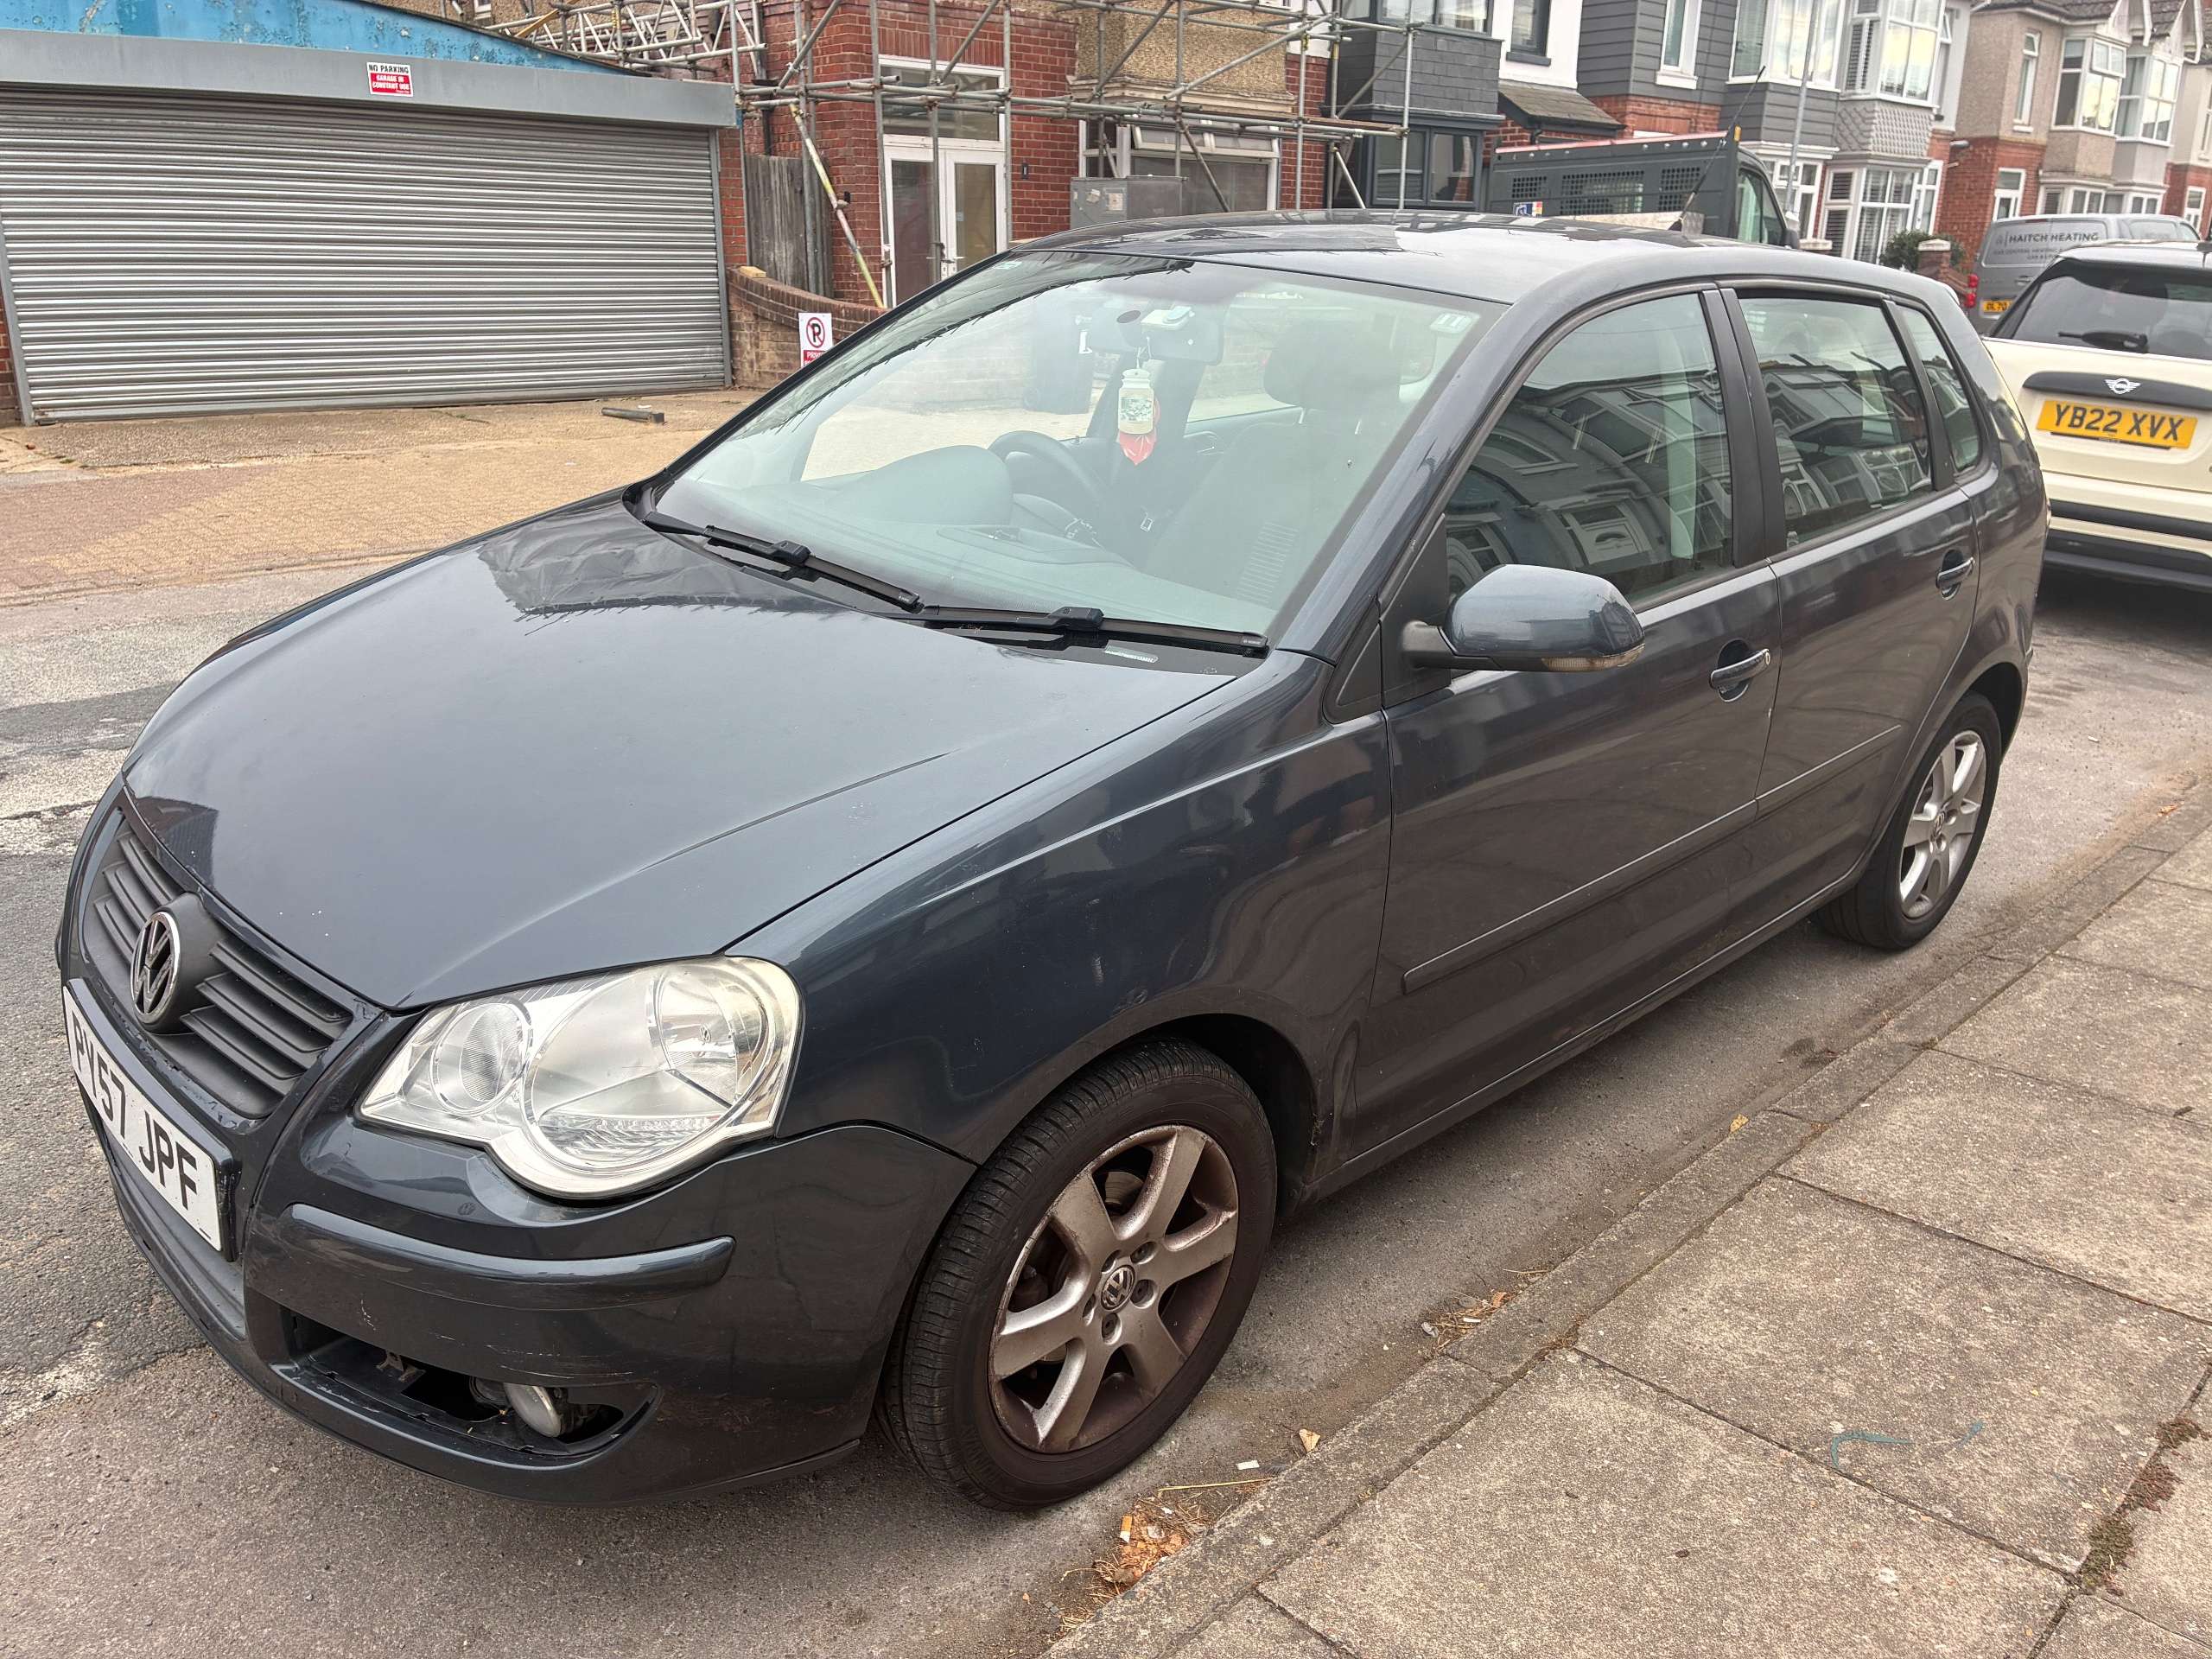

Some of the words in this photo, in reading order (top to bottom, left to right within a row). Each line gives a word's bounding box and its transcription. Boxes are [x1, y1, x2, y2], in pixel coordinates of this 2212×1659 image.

[380, 65, 409, 73] PARKING
[2009, 232, 2048, 243] HAITCH
[2050, 232, 2099, 242] HEATING
[2055, 404, 2123, 433] YB22
[2126, 412, 2184, 442] XVX
[71, 1008, 127, 1140] PY57
[138, 1109, 198, 1211] JPF
